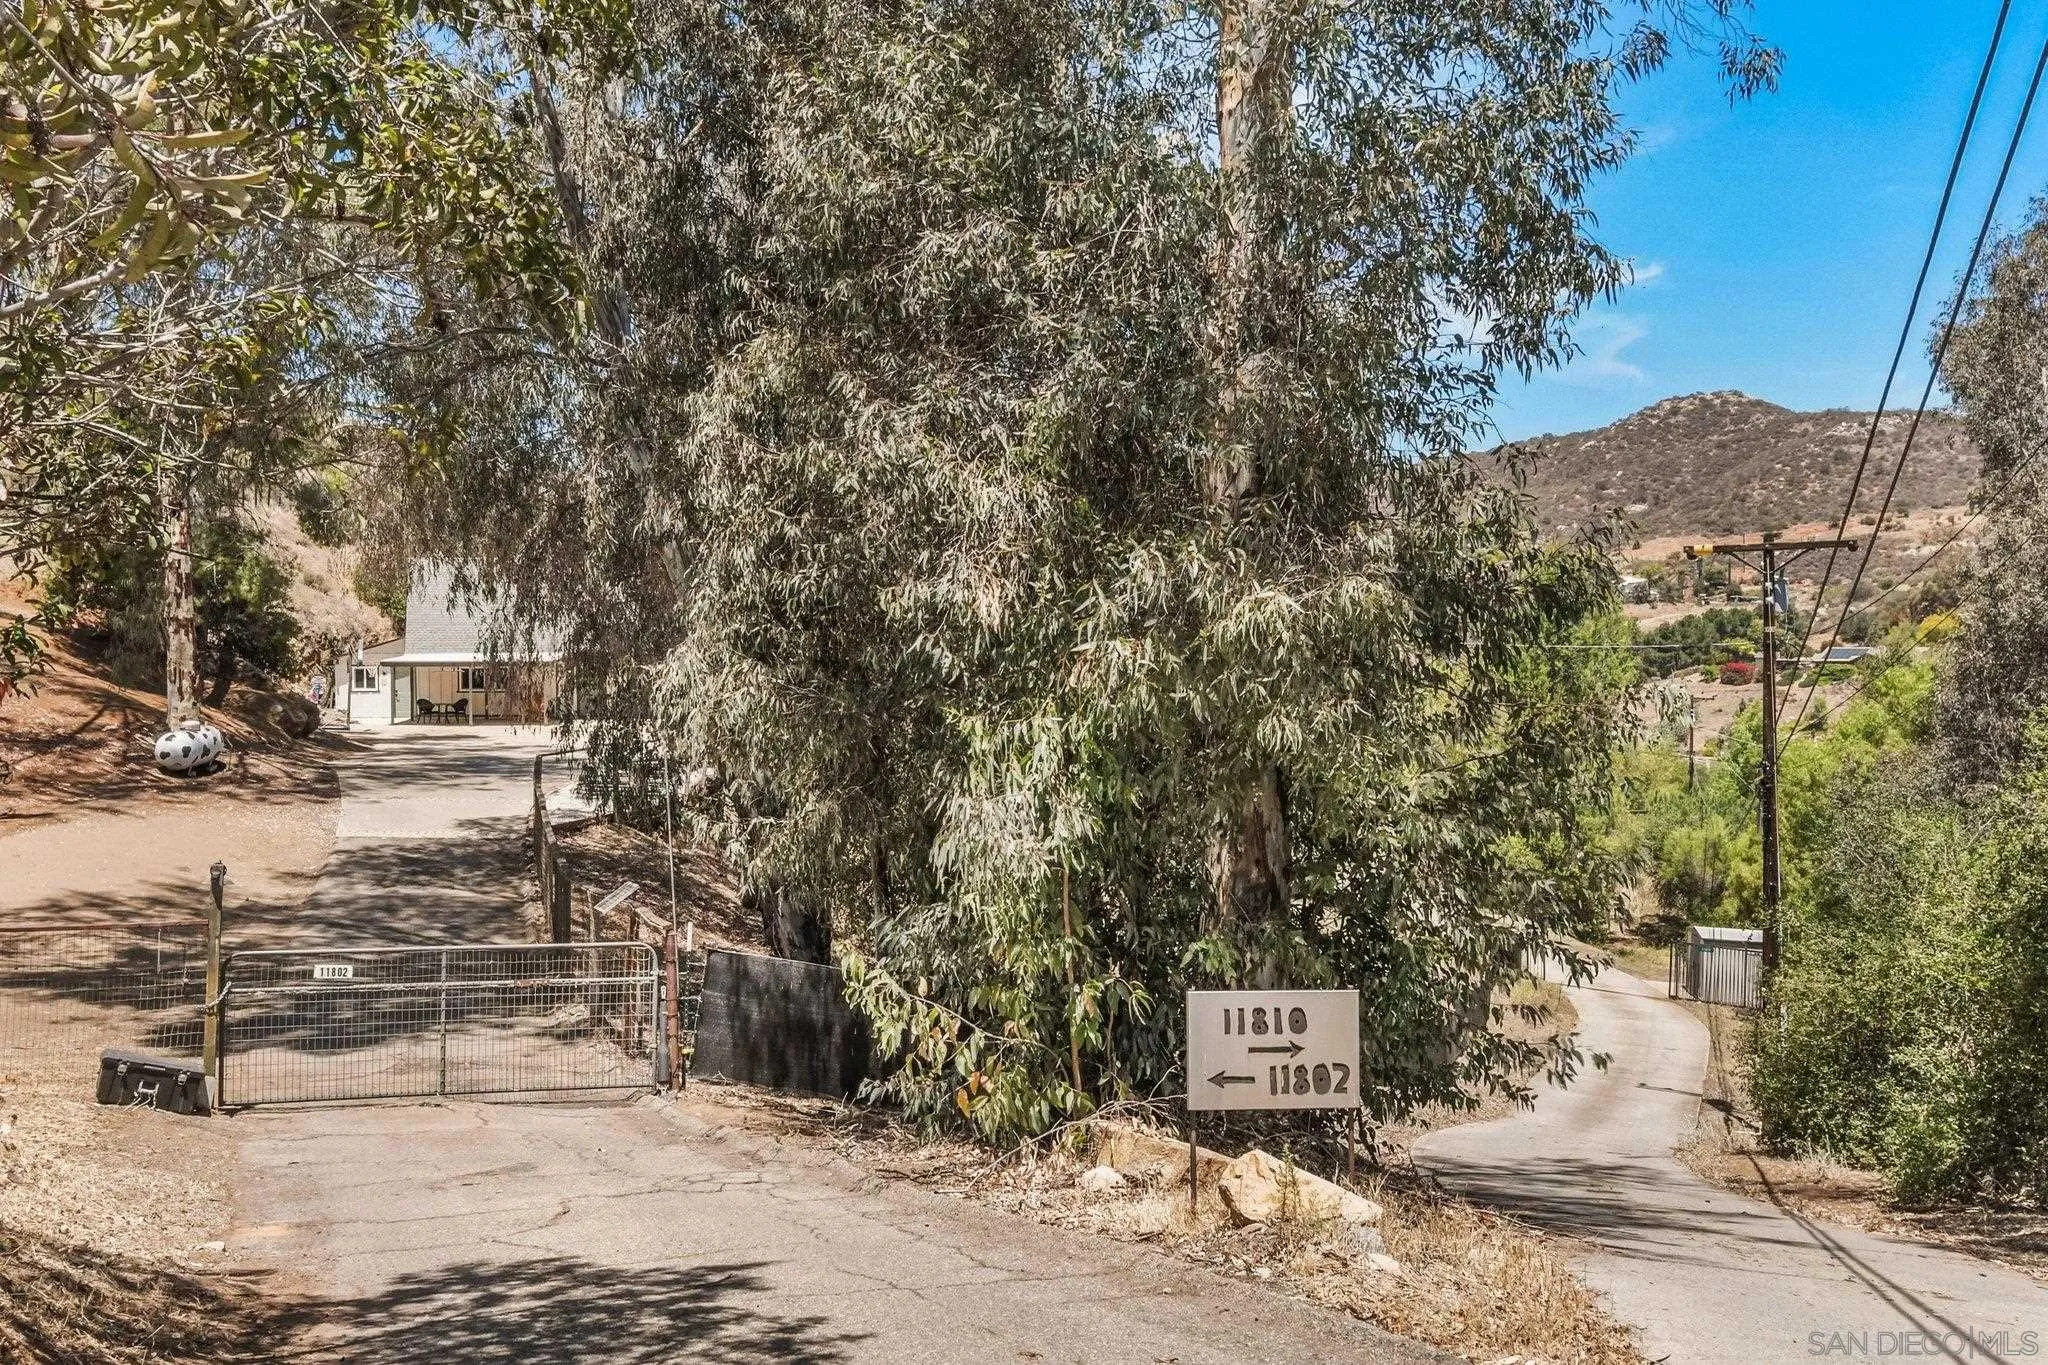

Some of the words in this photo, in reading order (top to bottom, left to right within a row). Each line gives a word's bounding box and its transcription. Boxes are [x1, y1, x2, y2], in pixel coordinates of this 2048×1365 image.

[320, 967, 348, 977] 11802
[1224, 1007, 1307, 1035] 11810
[1269, 1062, 1351, 1096] 11802
